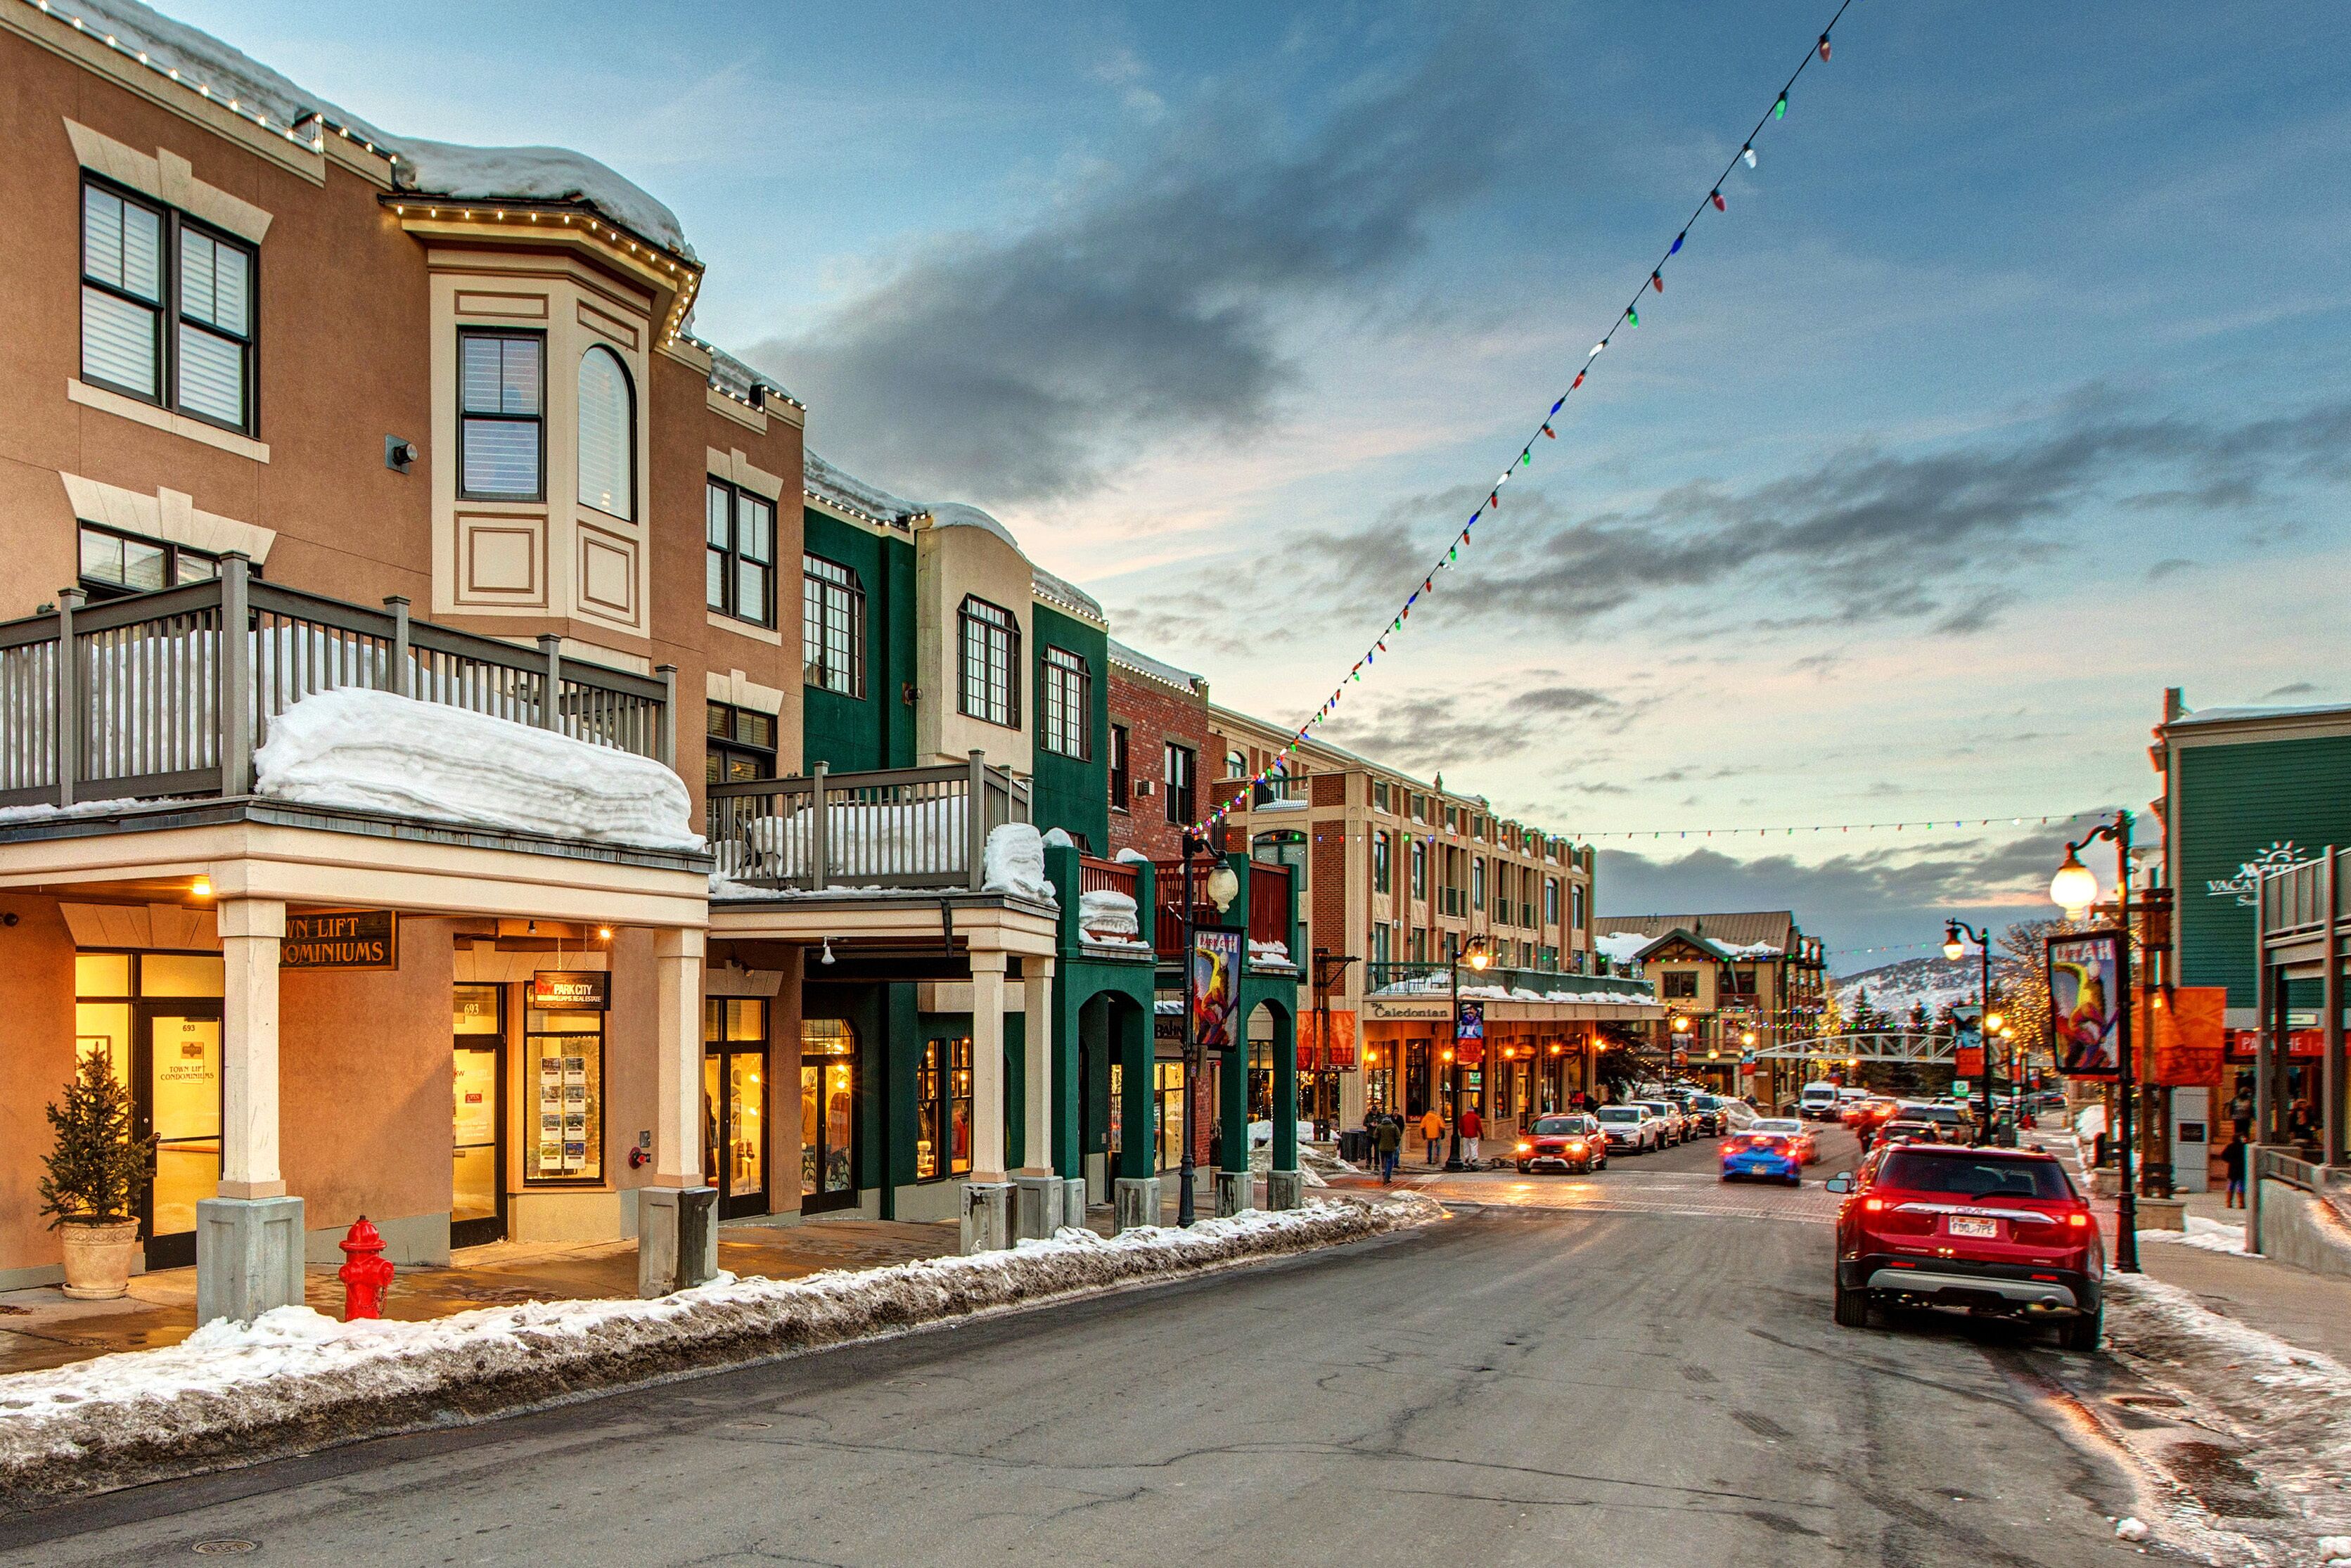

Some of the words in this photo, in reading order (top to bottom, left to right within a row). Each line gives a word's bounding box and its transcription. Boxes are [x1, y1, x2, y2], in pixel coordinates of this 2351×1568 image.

[318, 917, 359, 938] LIFT
[1197, 934, 1238, 953] UTAH
[1200, 937, 1218, 946] PARK
[2054, 939, 2113, 962] UTAH
[553, 984, 575, 995] PARK
[575, 984, 592, 995] CITY
[463, 1003, 479, 1015] 693
[1375, 1007, 1448, 1018] Caledonian
[160, 1072, 214, 1081] CONDOMINIUMS
[1956, 1207, 1991, 1215] GMC
